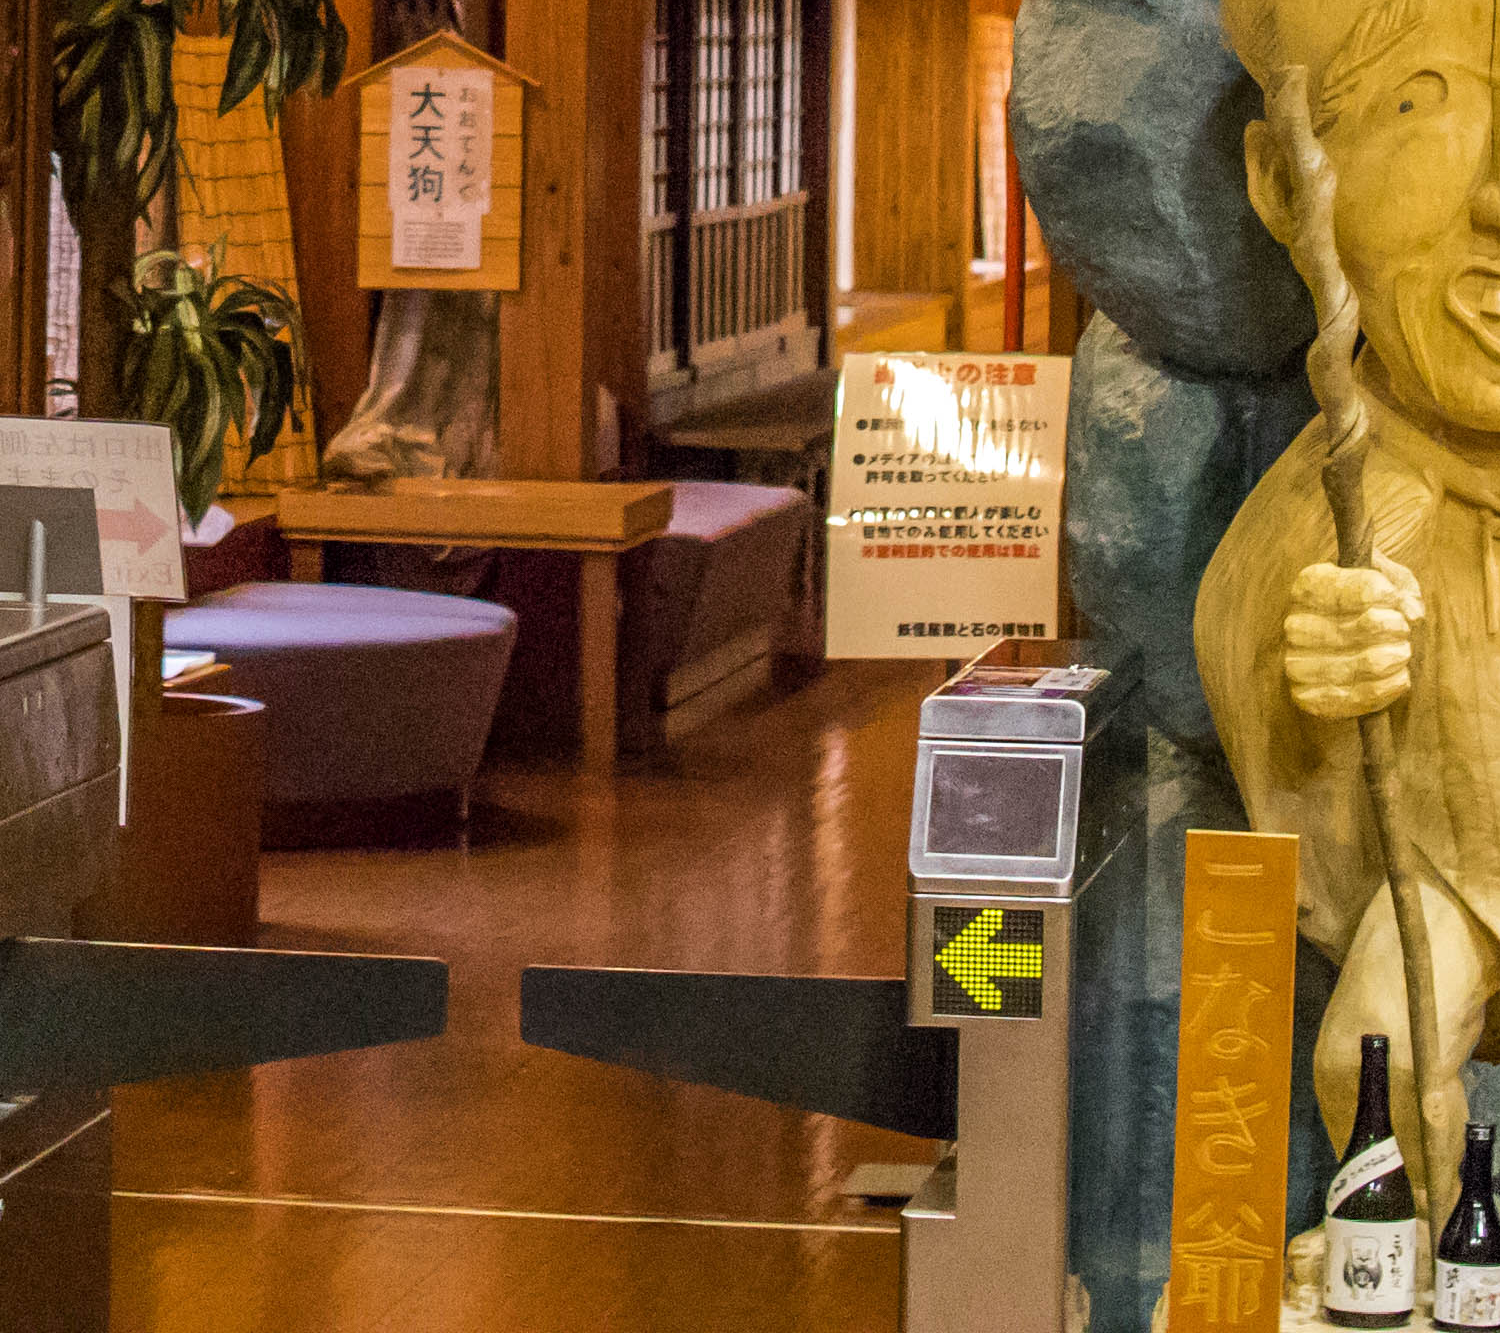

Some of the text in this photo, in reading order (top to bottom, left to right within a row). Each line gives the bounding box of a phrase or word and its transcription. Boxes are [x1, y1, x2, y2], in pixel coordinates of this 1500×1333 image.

[409, 82, 446, 203] 大天狗
[1174, 862, 1277, 1324] こなき爺
